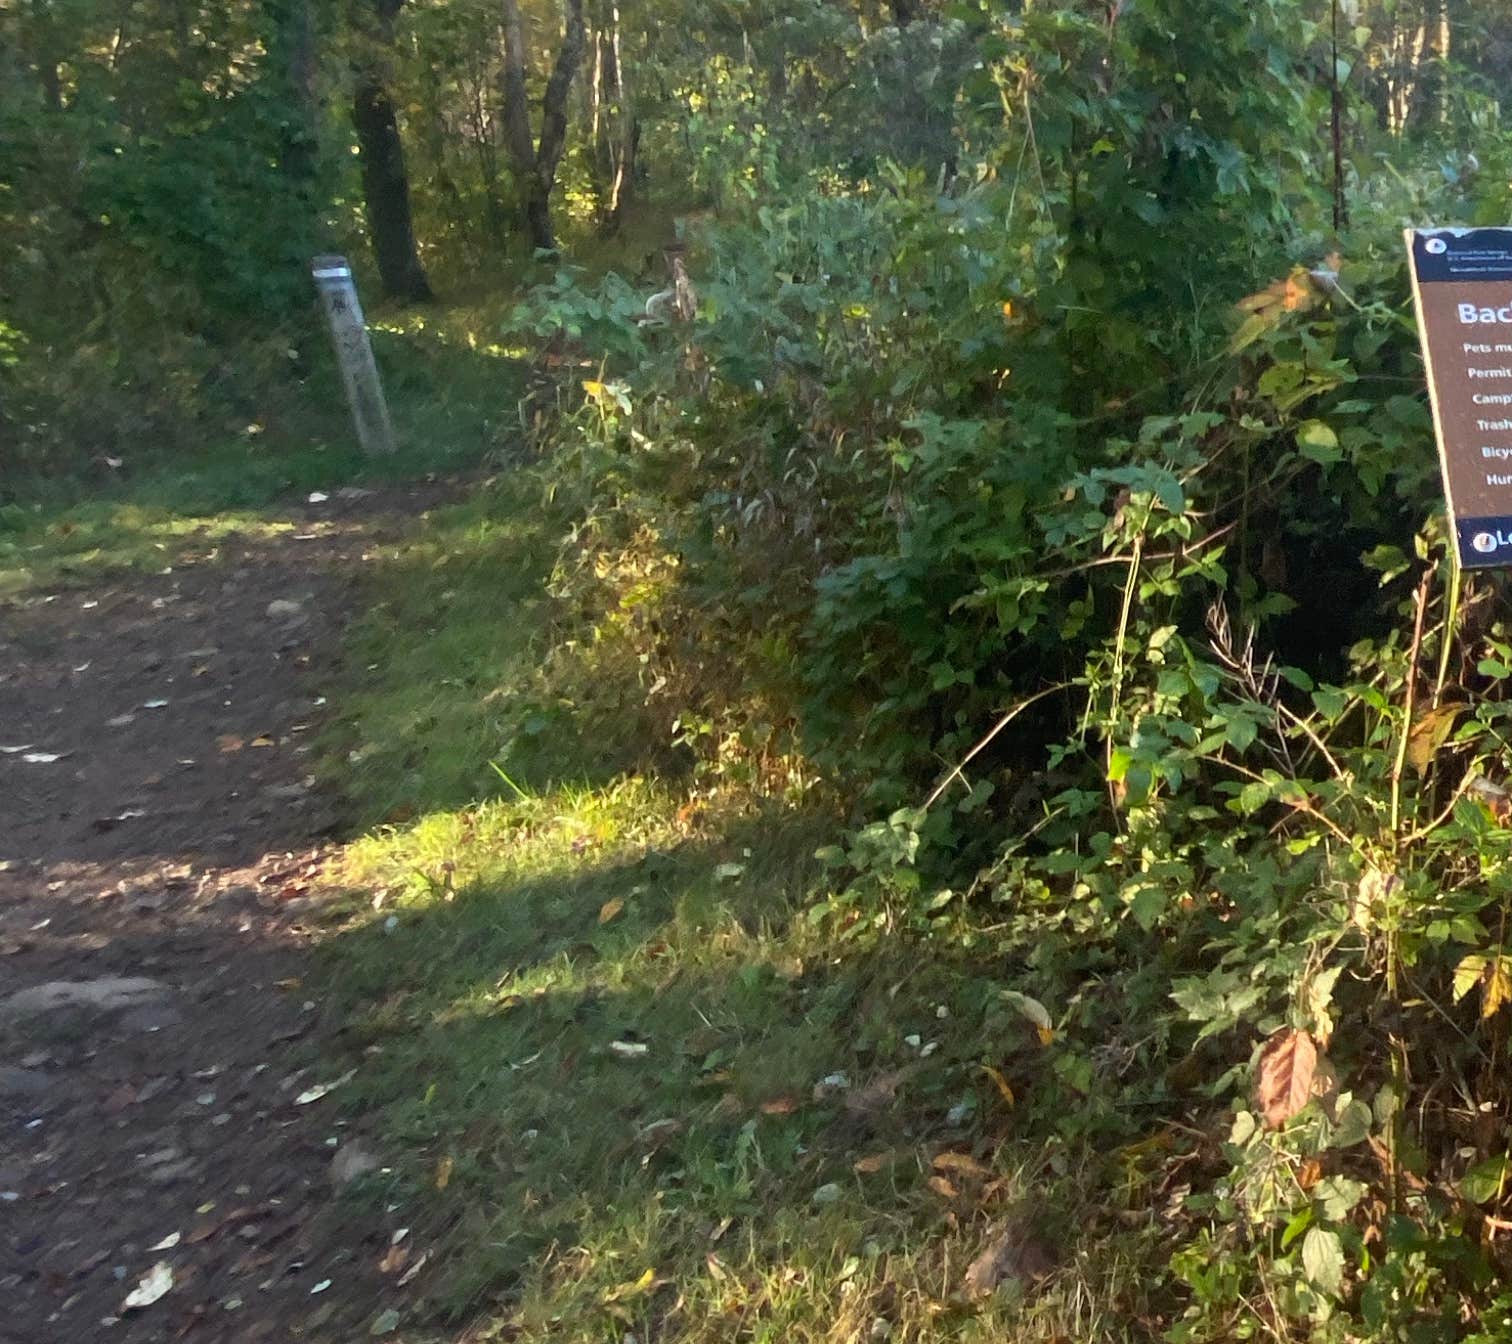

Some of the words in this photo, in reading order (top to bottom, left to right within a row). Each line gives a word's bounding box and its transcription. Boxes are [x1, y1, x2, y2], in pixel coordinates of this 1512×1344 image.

[1463, 342, 1492, 353] Pets
[1467, 367, 1512, 378] Permit
[1477, 418, 1512, 431] Trash
